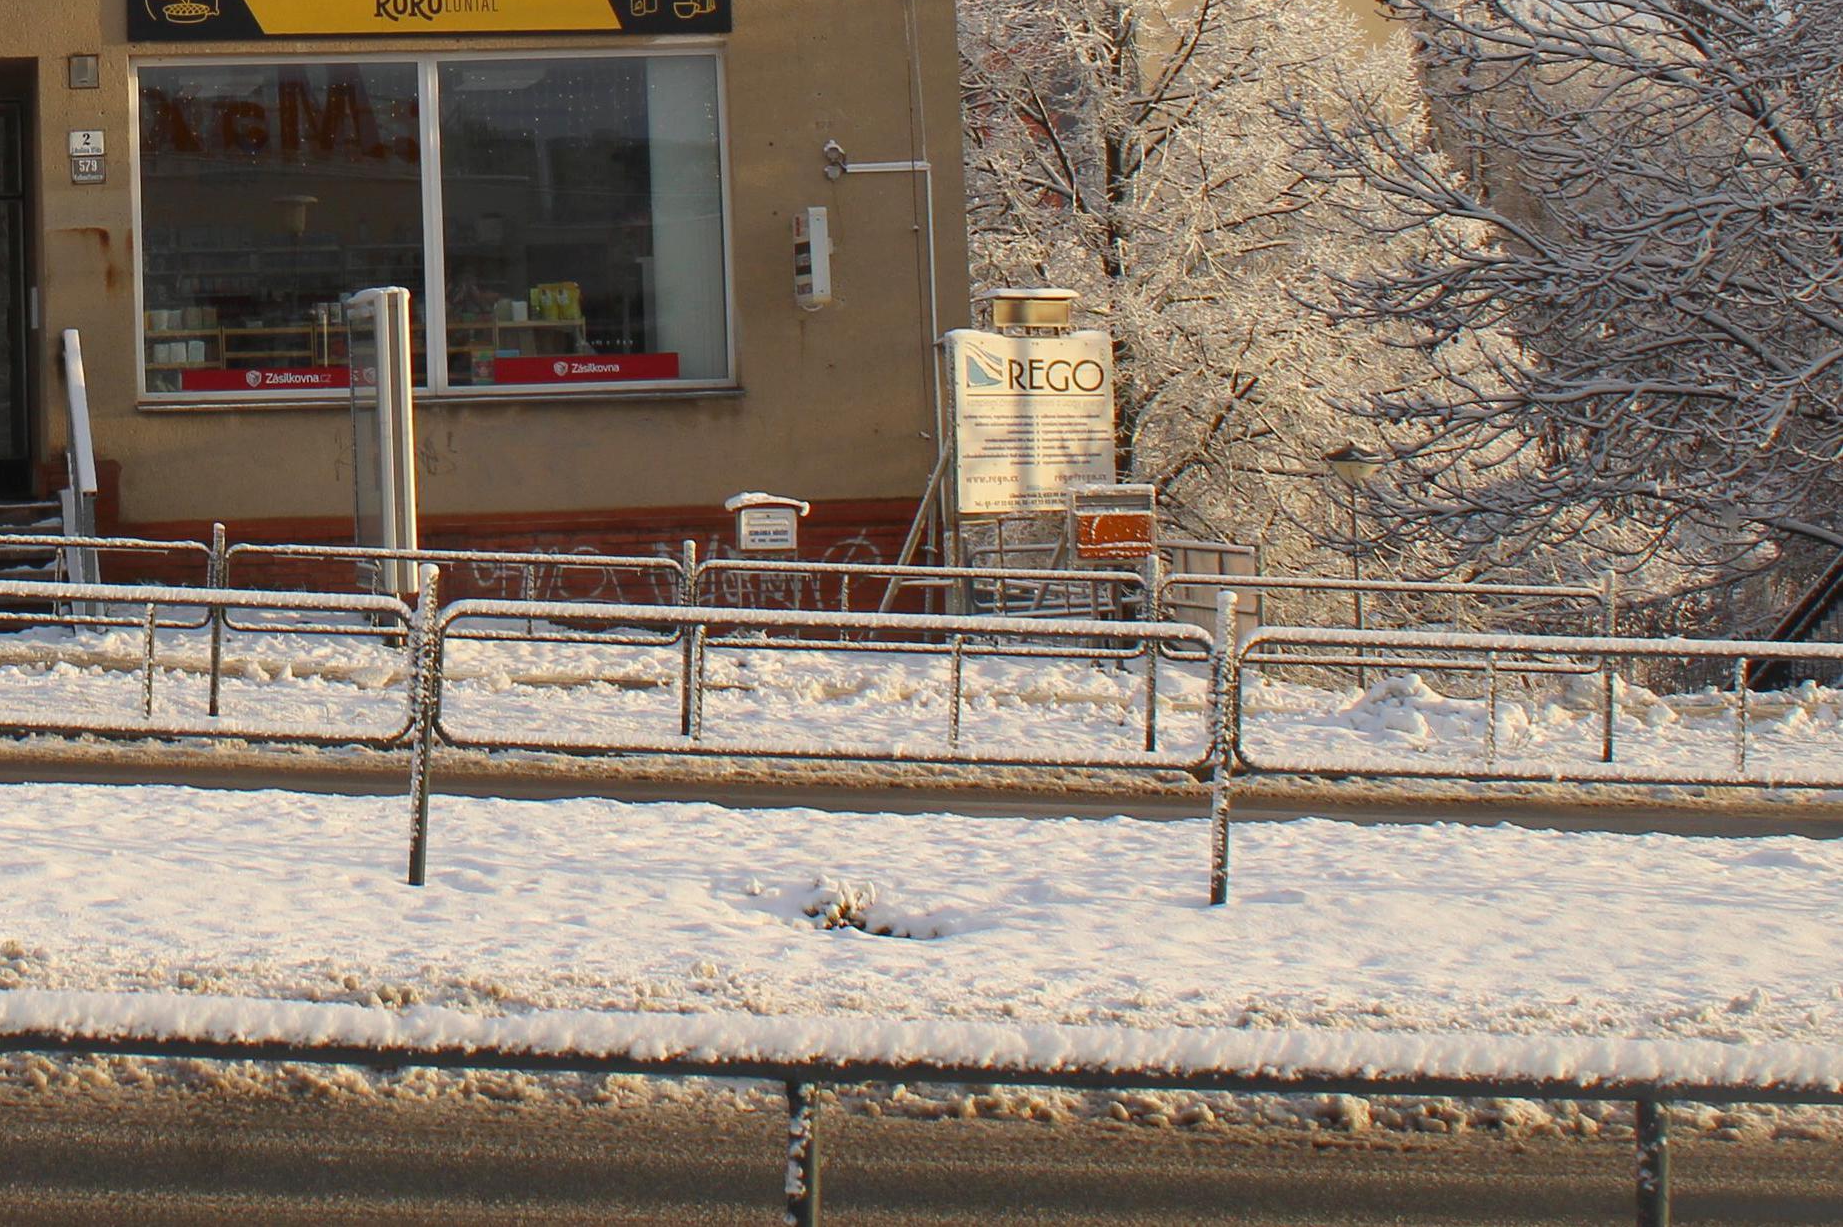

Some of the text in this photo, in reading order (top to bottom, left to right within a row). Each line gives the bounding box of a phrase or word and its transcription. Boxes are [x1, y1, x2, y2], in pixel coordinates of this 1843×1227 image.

[82, 133, 90, 146] 2
[78, 159, 98, 173] 579
[571, 363, 620, 374] Zásilkovna
[1009, 359, 1105, 391] REGO
[265, 372, 332, 384] Zásilkovna.cz
